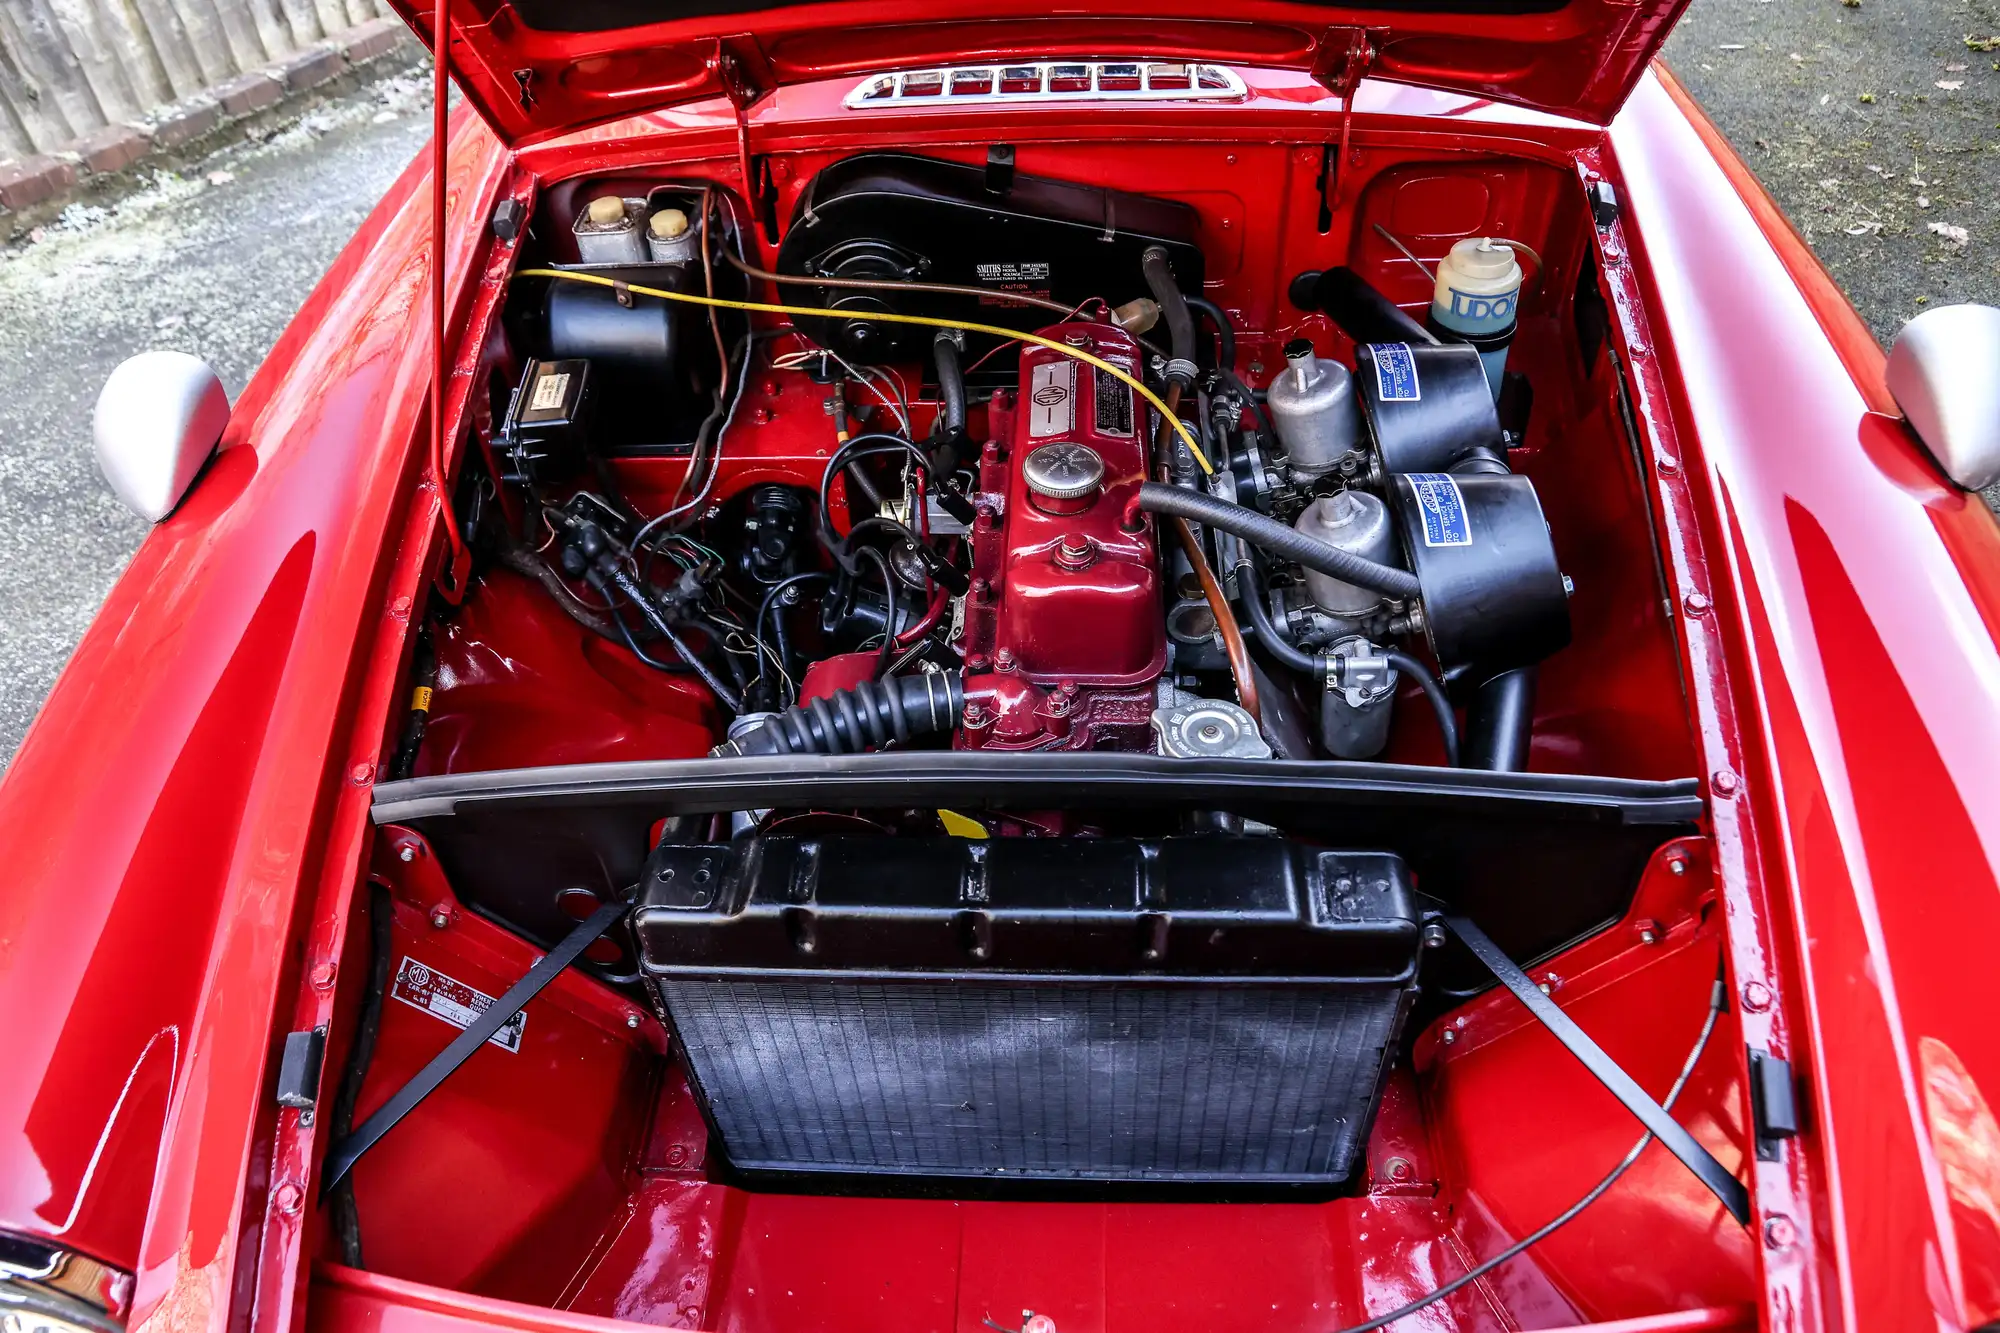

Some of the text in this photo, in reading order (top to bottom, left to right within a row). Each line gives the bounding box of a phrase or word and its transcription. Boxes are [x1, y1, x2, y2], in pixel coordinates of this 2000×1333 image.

[976, 264, 1002, 273] SMITHS
[1448, 286, 1520, 320] TUDOR
[1036, 387, 1065, 404] MG
[1447, 484, 1459, 510] HANDBOOK
[1440, 506, 1450, 526] SERVICE
[1446, 501, 1459, 542] TO VEHICLE
[410, 967, 428, 984] MG
